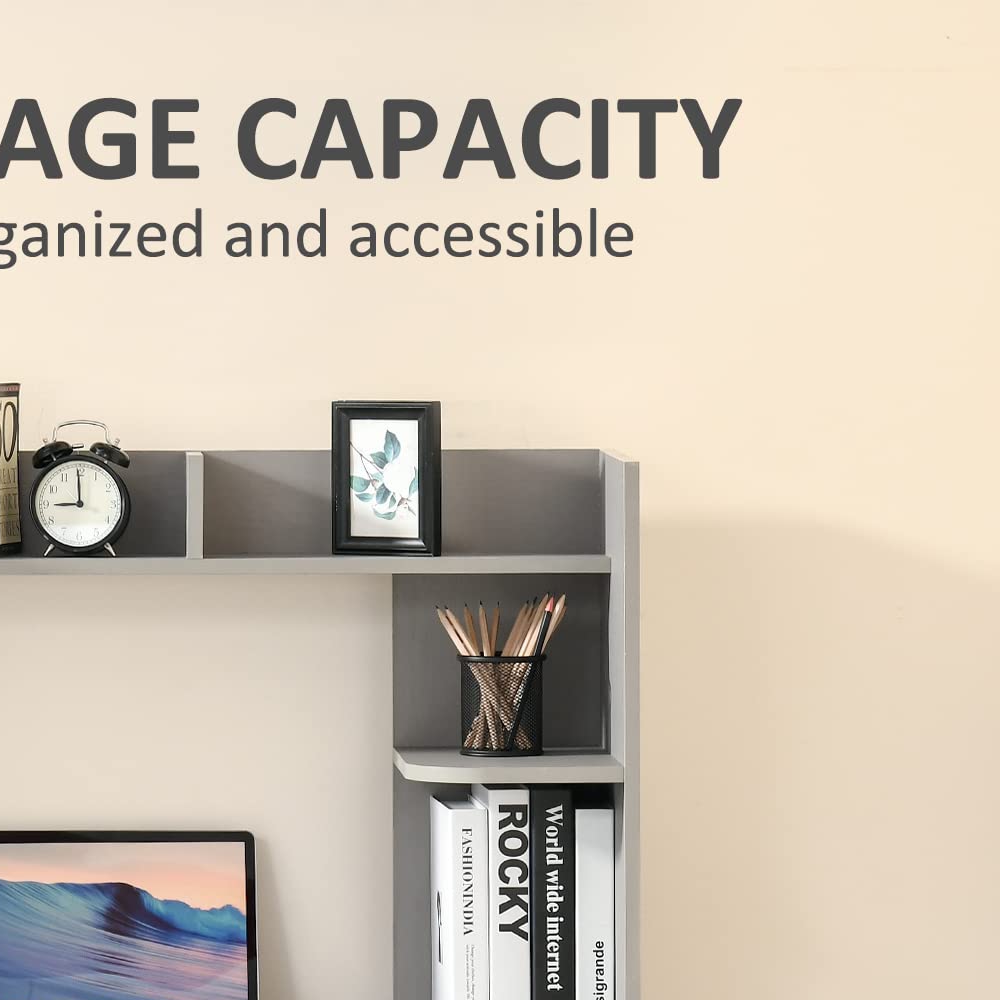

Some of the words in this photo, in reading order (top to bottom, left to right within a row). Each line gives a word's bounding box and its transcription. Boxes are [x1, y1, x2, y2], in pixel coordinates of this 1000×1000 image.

[49, 484, 58, 494] 10
[61, 472, 68, 483] 11
[105, 482, 112, 493] 2
[43, 500, 50, 510] 9
[48, 515, 55, 526] 8
[545, 804, 563, 865] World
[461, 828, 474, 936] FASHIONINDIA
[498, 803, 529, 942] ROCKY
[545, 869, 565, 913] wide
[545, 916, 565, 991] internet
